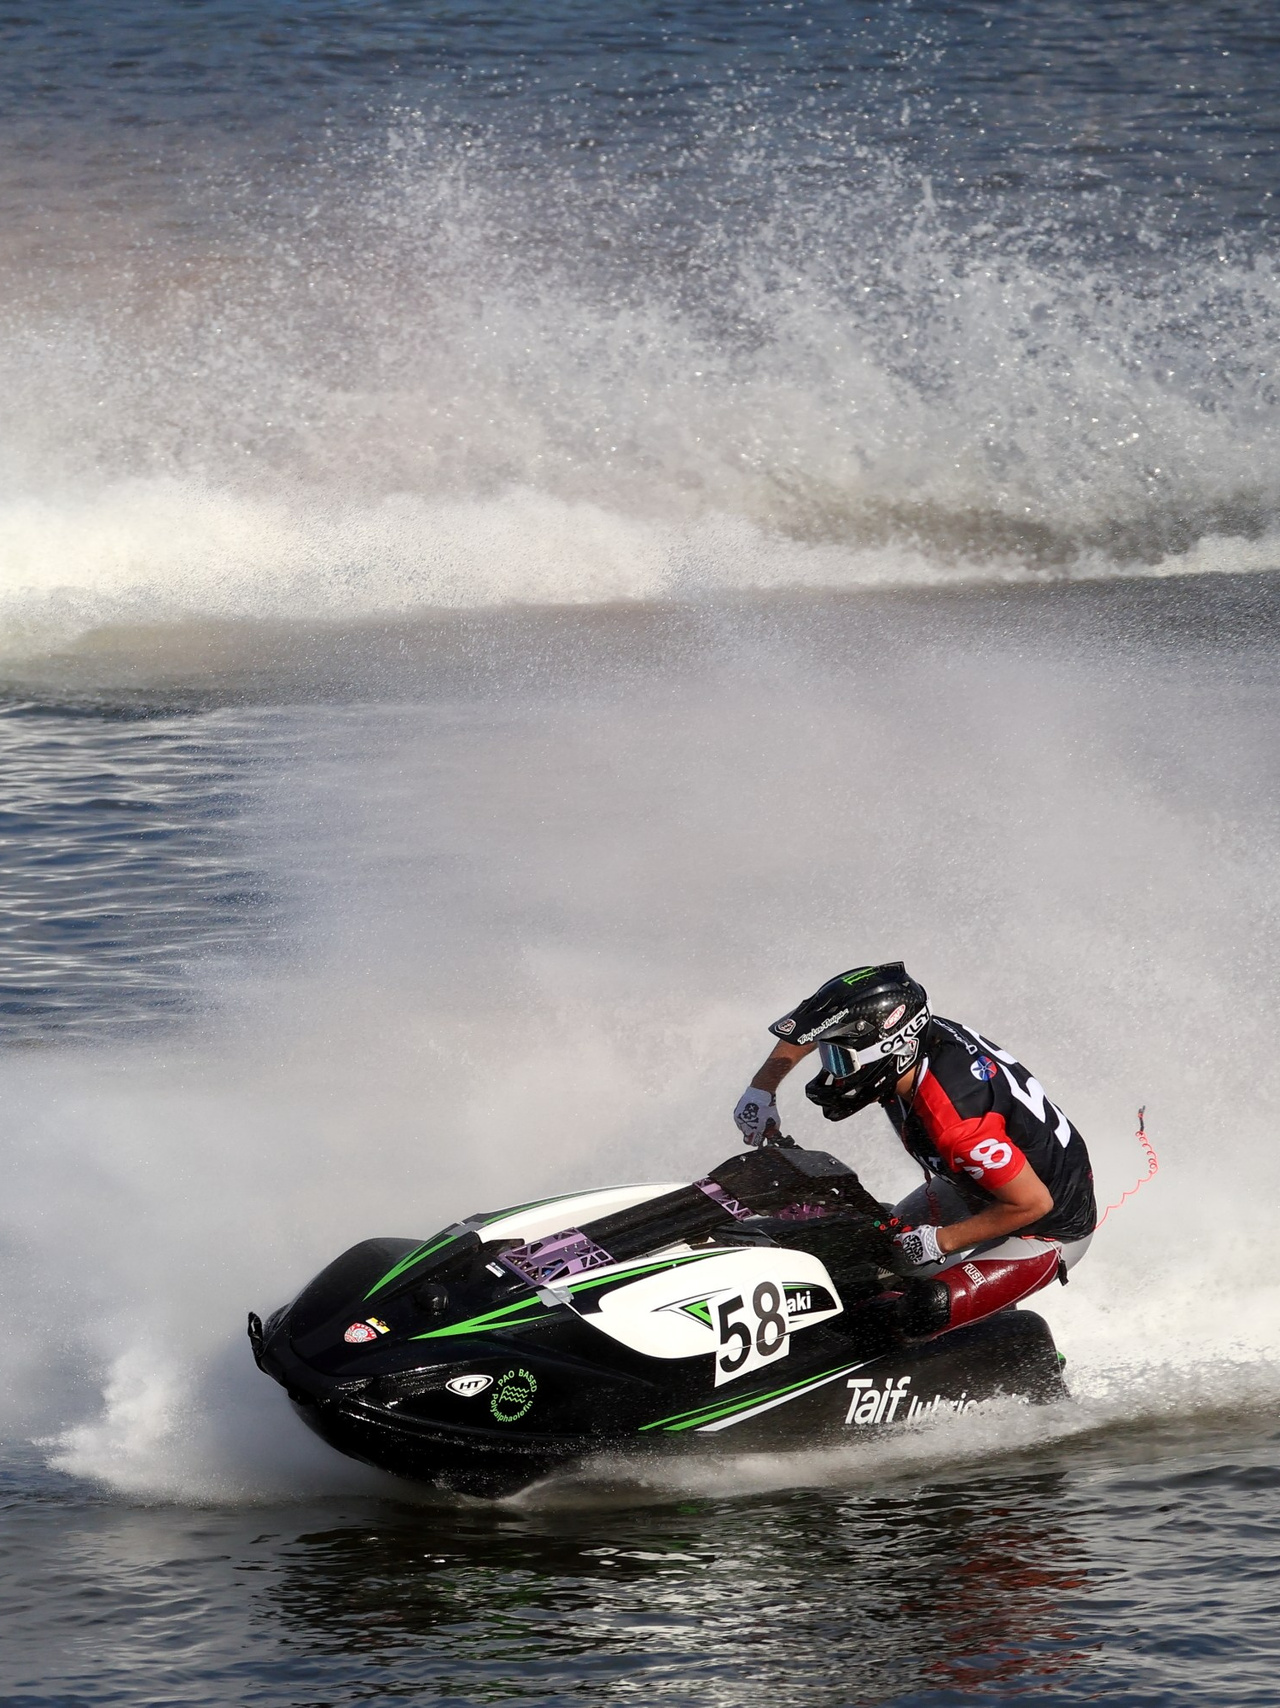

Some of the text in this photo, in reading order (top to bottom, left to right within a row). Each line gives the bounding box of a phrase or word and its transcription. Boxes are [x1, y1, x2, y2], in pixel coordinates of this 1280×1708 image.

[880, 1012, 930, 1054] OAKLEY
[962, 1263, 987, 1287] RUSH
[717, 1281, 786, 1373] 58
[497, 1368, 538, 1393] PAO BASED
[845, 1376, 912, 1425] Taif
